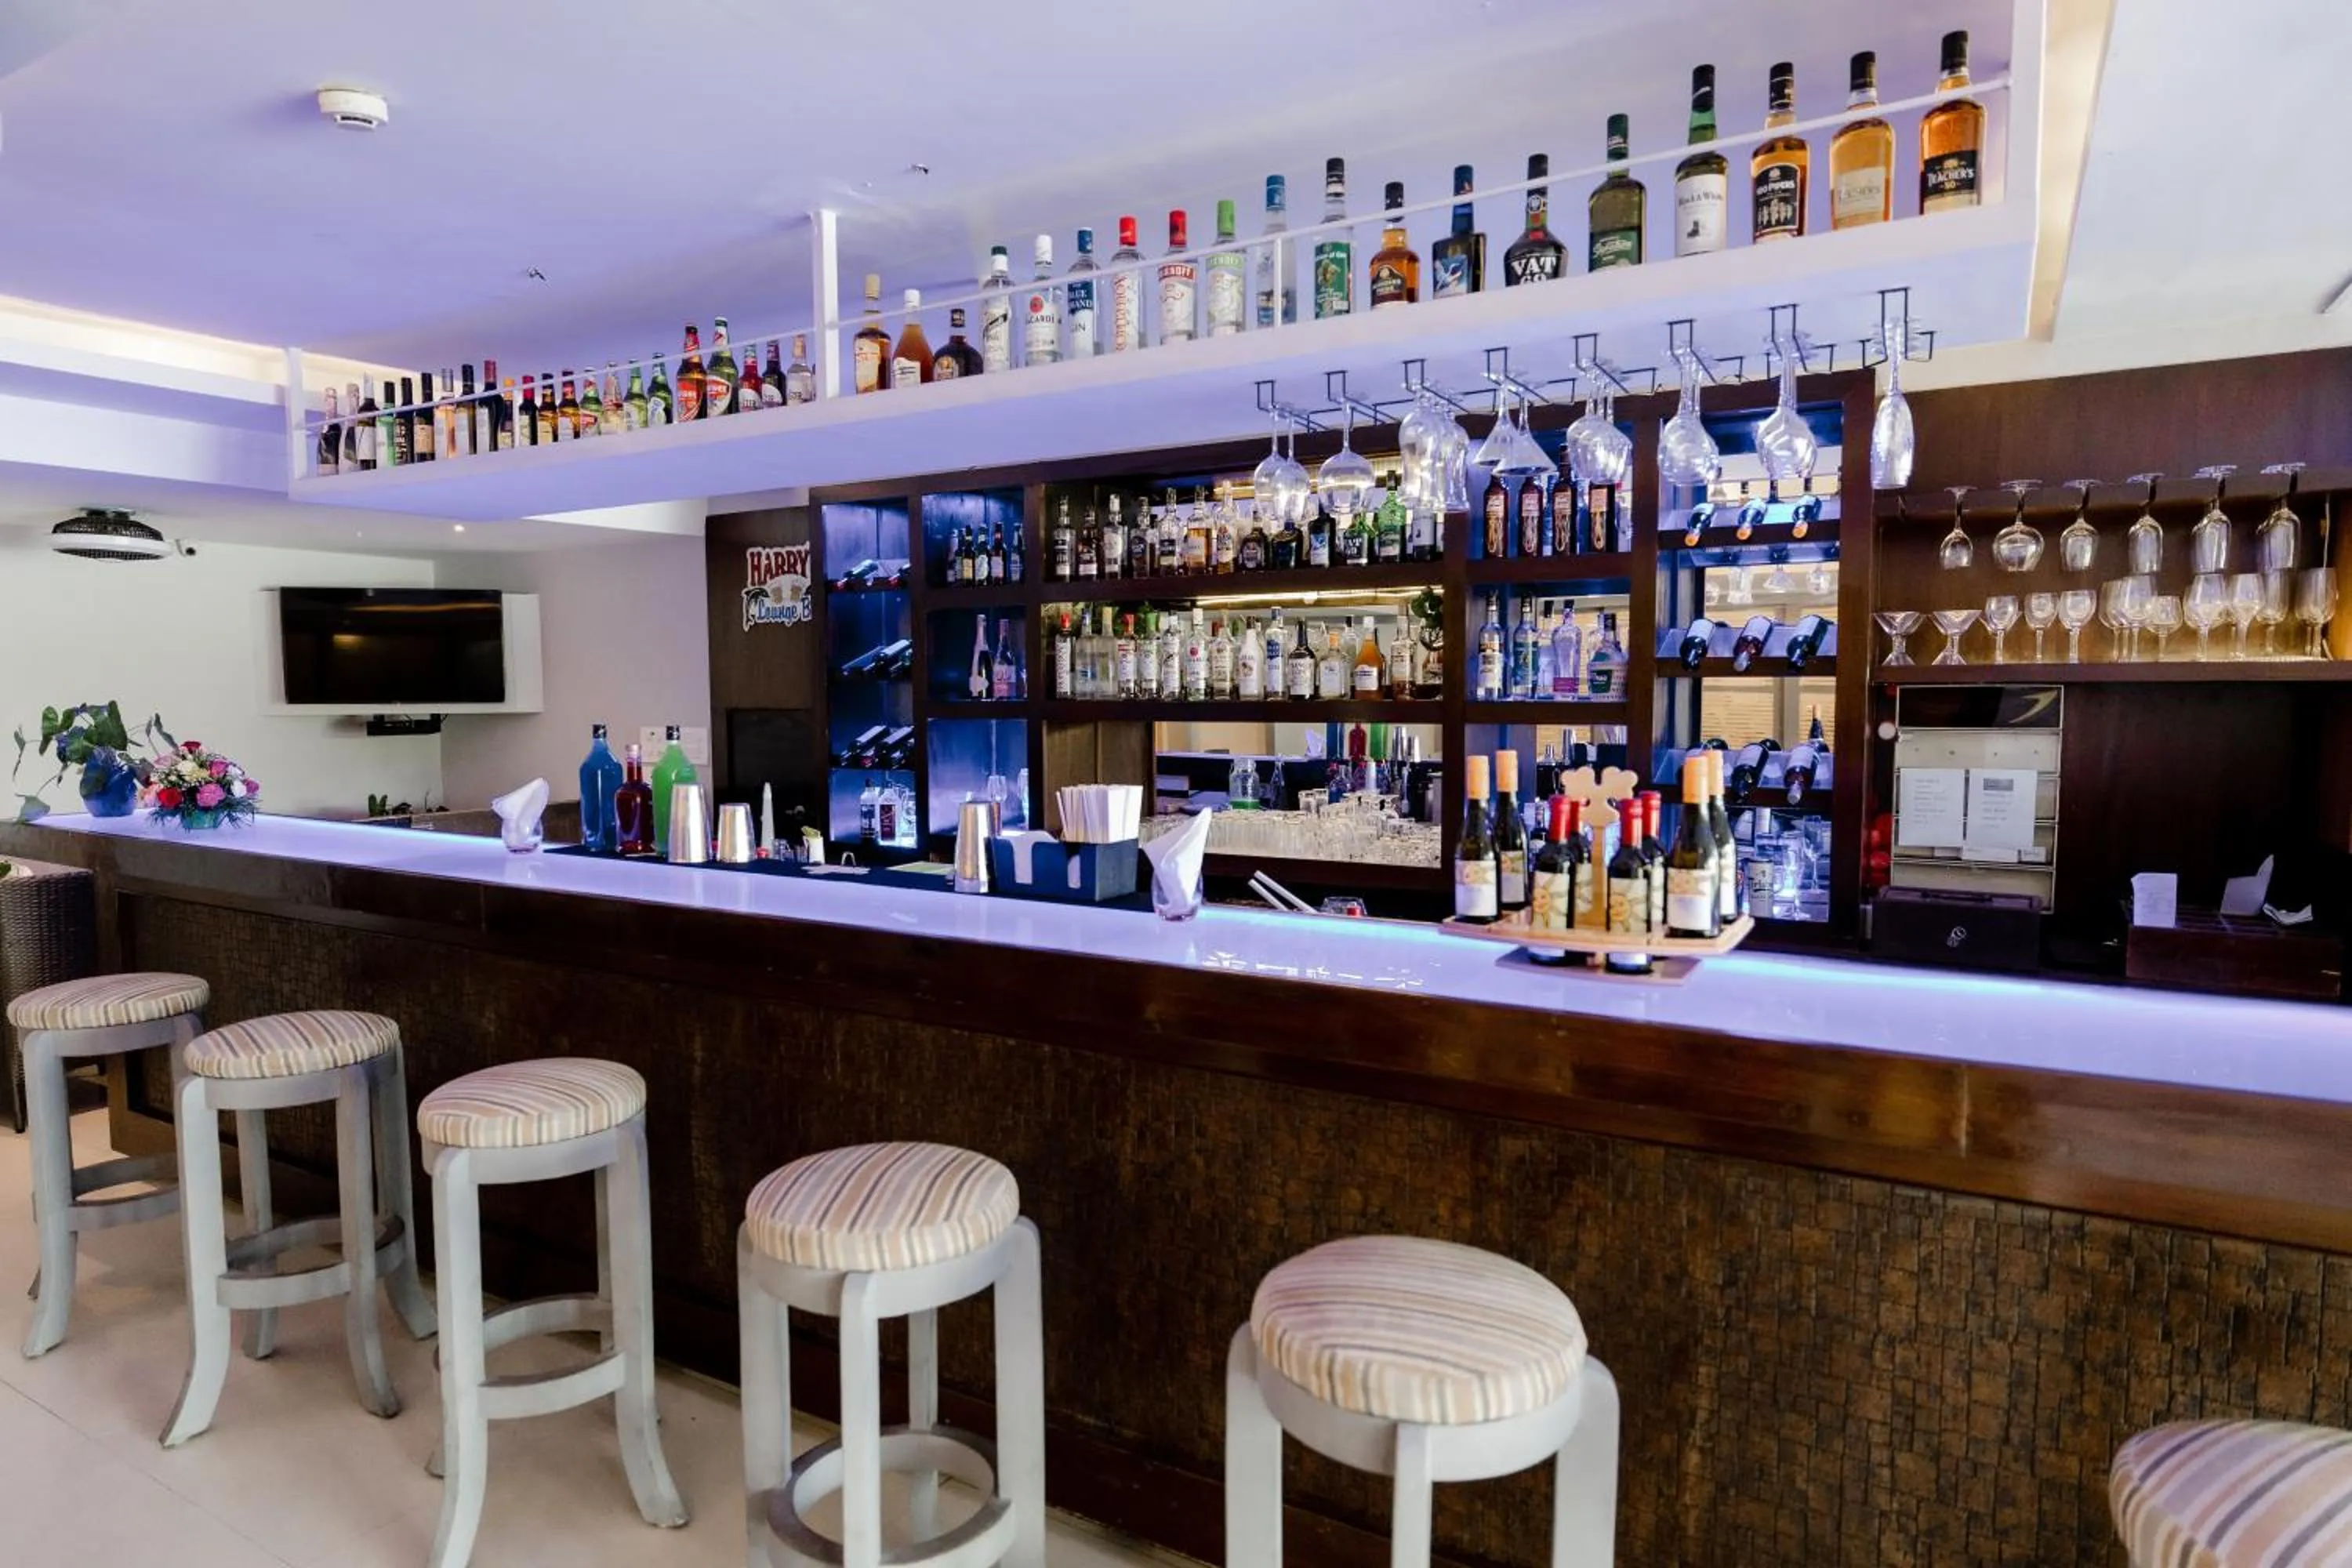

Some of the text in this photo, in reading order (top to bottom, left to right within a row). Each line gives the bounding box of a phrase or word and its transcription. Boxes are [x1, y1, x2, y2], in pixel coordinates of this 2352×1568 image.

[1927, 167, 1974, 187] TEACHER'S
[1511, 256, 1557, 277] VAT
[757, 598, 797, 622] Lounge
